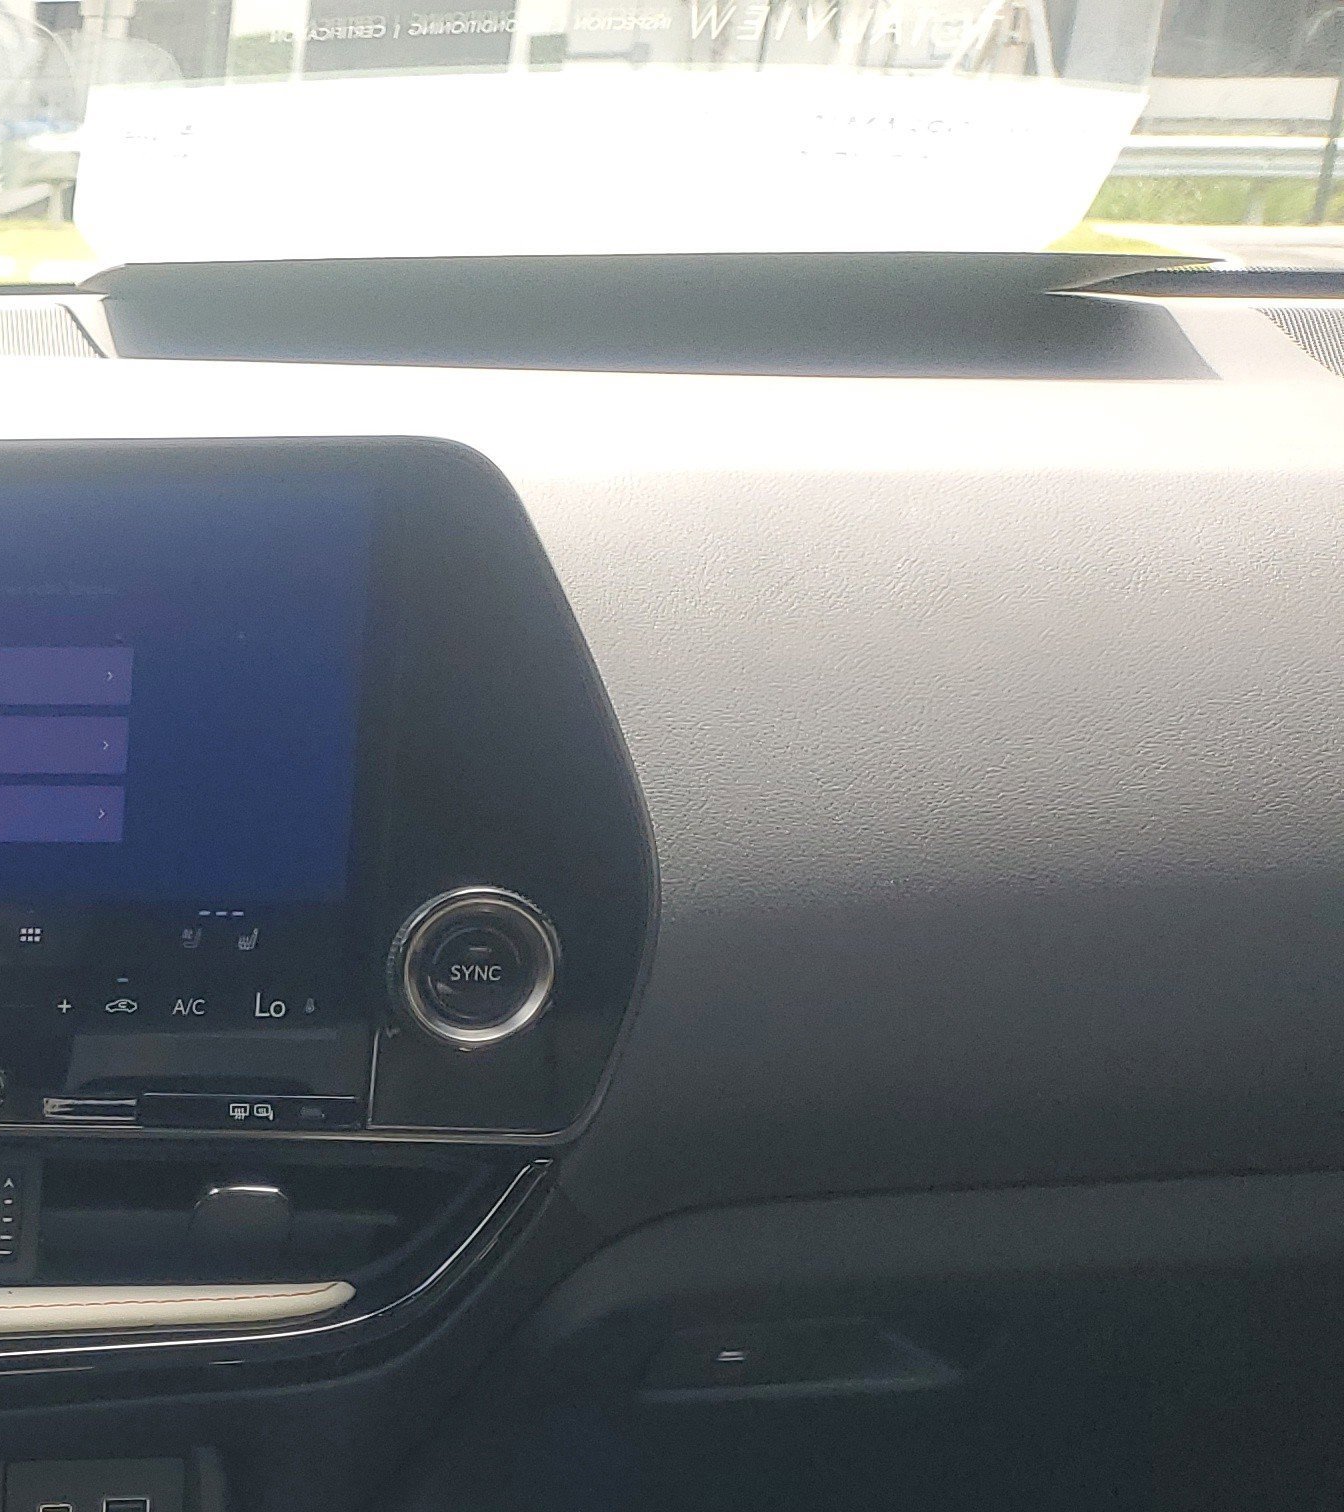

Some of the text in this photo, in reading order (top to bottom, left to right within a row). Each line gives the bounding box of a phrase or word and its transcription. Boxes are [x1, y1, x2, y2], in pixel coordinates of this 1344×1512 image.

[450, 965, 503, 981] SYNC
[171, 997, 207, 1017] A/C
[254, 993, 287, 1020] Lo
